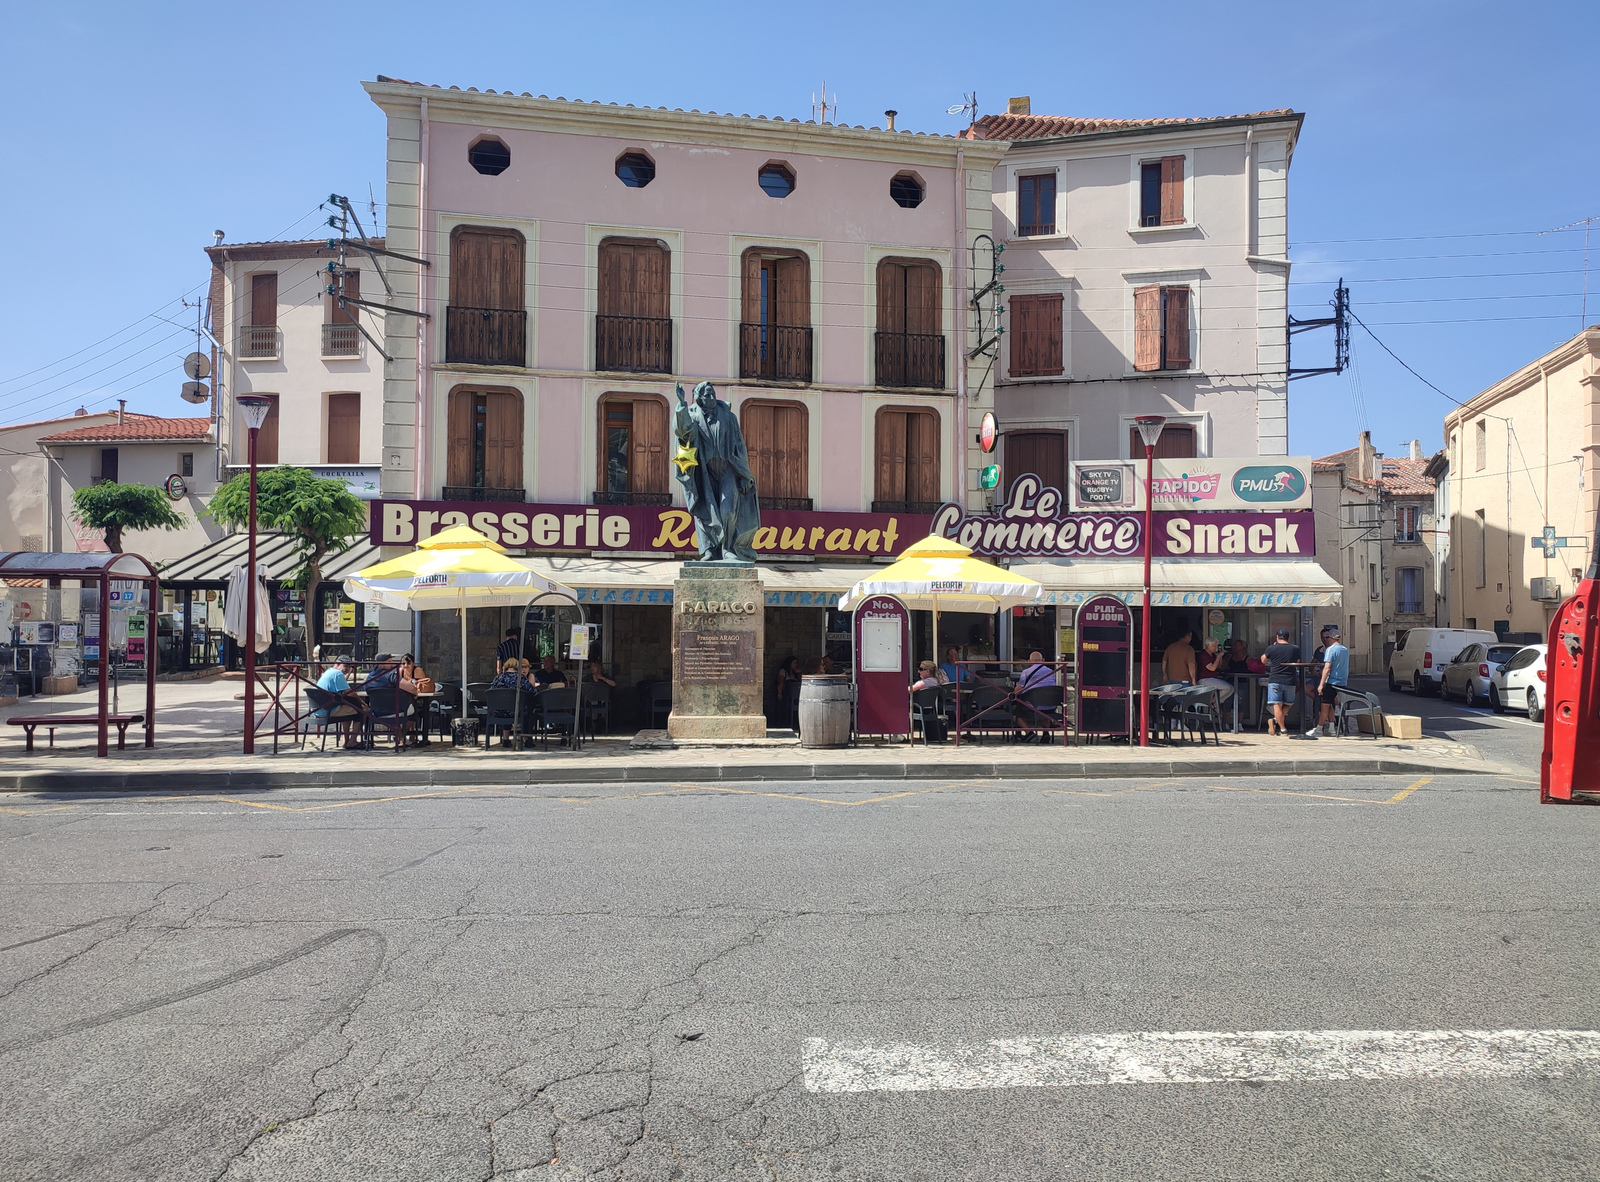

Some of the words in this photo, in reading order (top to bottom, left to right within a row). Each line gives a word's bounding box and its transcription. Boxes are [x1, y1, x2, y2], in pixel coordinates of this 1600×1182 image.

[1152, 481, 1212, 493] RAPIDO
[1239, 479, 1274, 492] PMU
[1005, 478, 1057, 519] Le
[651, 509, 899, 553] Raurant
[935, 506, 1135, 550] Commerce
[1166, 517, 1301, 555] Snack
[413, 574, 447, 585] PELFORTH
[931, 581, 963, 589] PELFORTH
[112, 592, 118, 600] 9
[576, 588, 674, 604] GLACIER
[1183, 592, 1304, 605] COMMERCE
[872, 600, 895, 610] Nos
[1094, 605, 1117, 613] PLAT
[864, 611, 902, 619] Cartes
[1086, 612, 1099, 621] DU
[1100, 613, 1124, 621] JOUR
[1082, 642, 1099, 650] Menu
[1081, 689, 1098, 697] Menu
